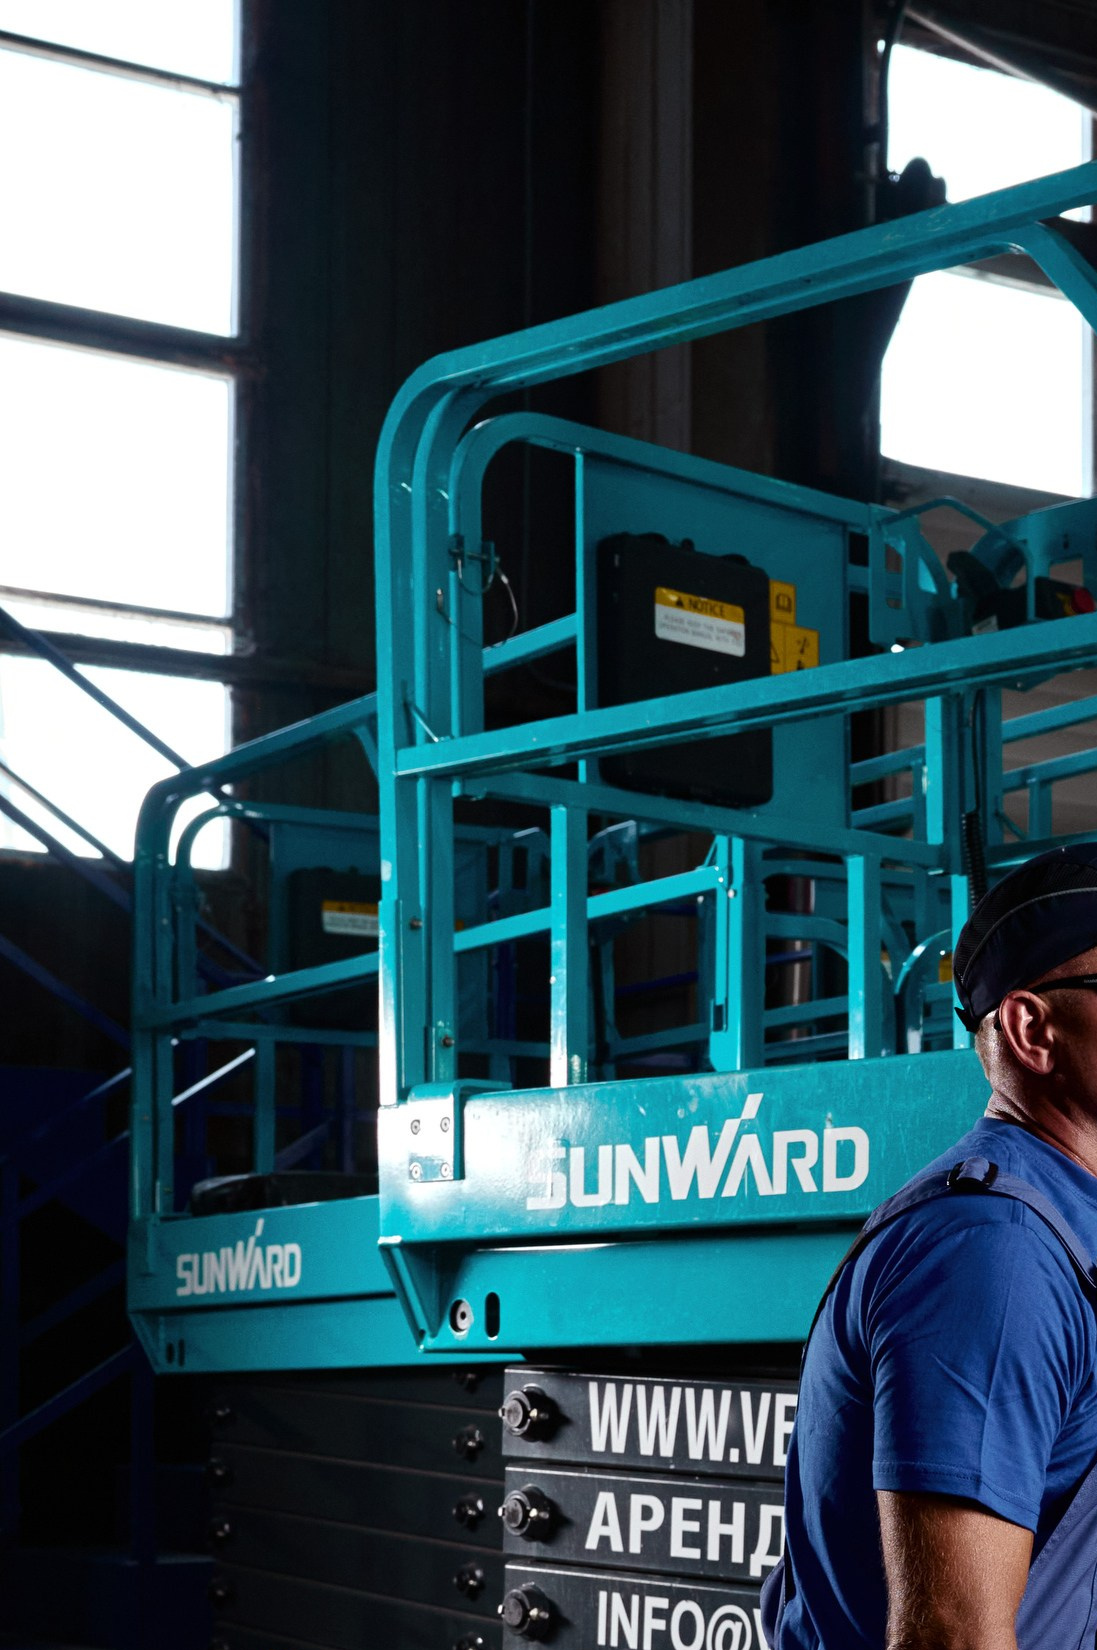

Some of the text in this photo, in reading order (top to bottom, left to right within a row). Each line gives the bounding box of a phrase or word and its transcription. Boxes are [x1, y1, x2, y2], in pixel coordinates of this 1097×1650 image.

[688, 598, 726, 617] NOTICE
[525, 1092, 870, 1210] SUNWARD
[176, 1217, 302, 1297] SUNWARD
[588, 1381, 799, 1467] WWW.VE
[584, 1491, 786, 1577] АРЕНД
